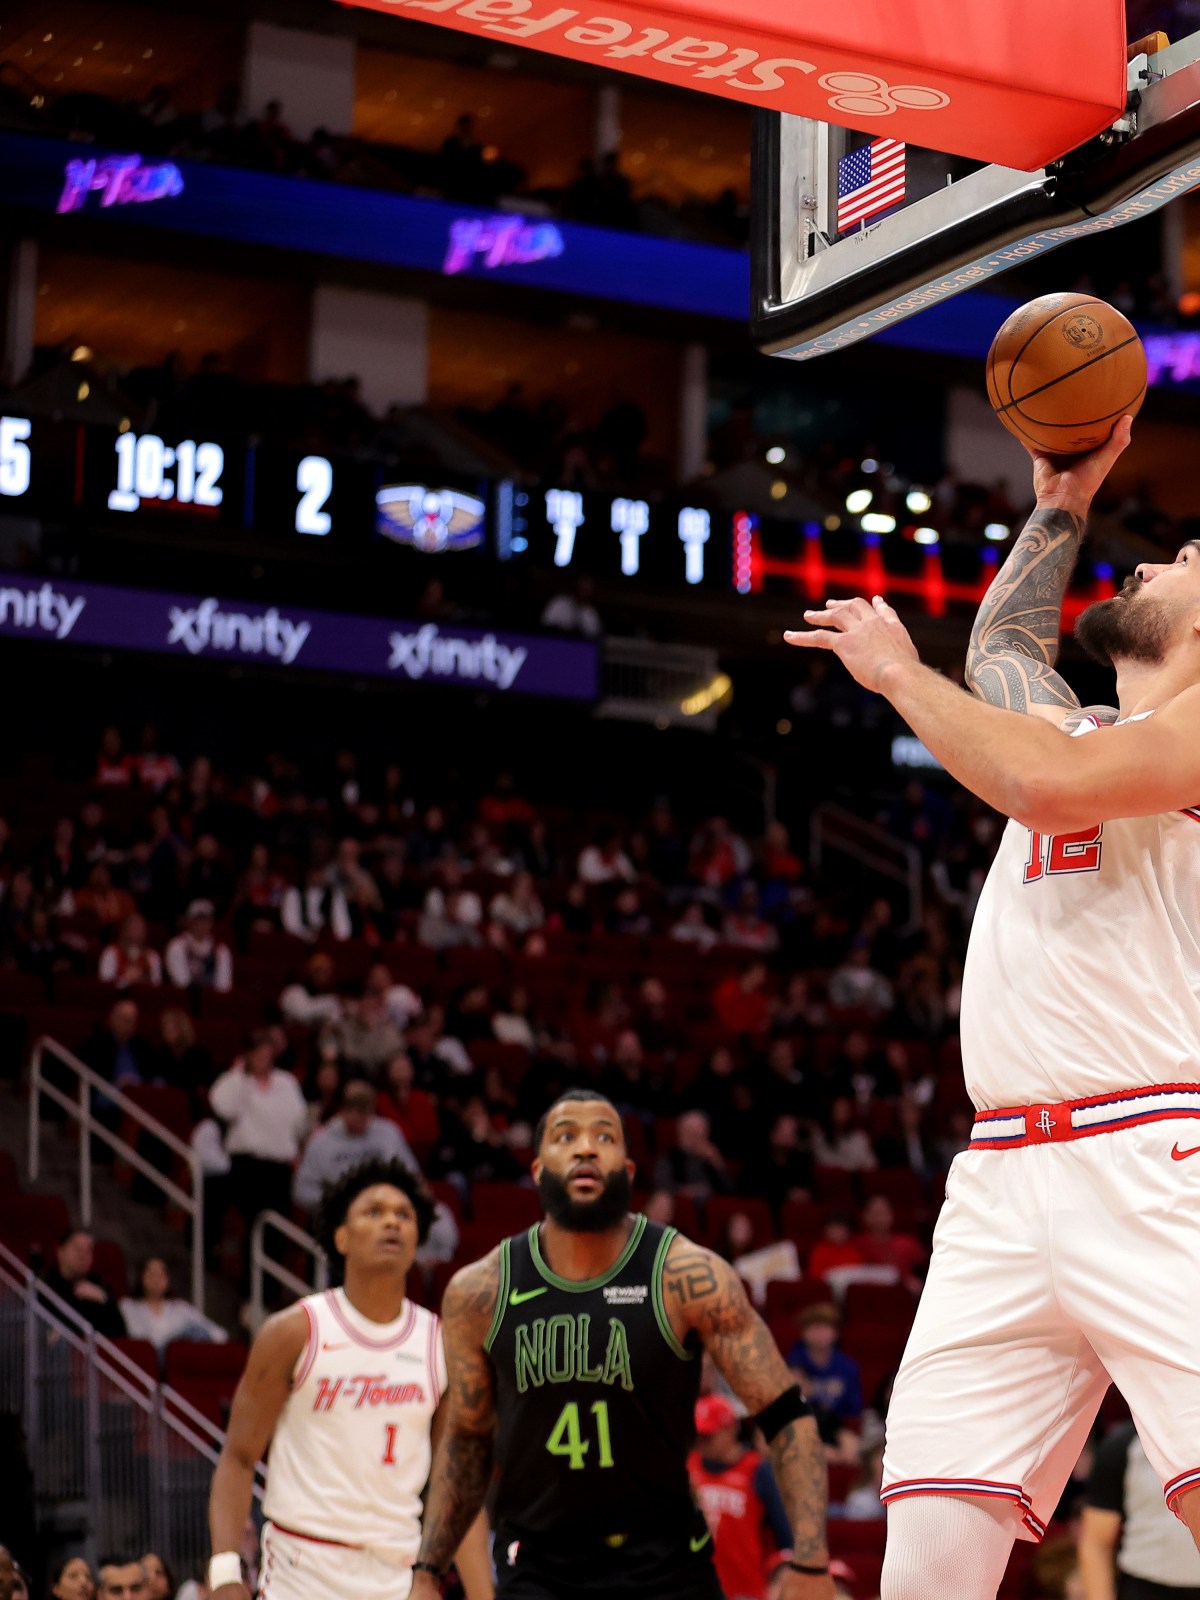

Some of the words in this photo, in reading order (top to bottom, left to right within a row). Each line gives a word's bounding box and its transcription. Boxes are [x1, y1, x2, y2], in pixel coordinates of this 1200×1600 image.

[868, 265, 993, 321] veraclinic.net
[996, 240, 1045, 261] Hair
[1035, 200, 1153, 241] Transplant
[115, 431, 225, 507] 10:12
[295, 455, 334, 536] 2
[166, 598, 311, 664] xfinity
[388, 623, 528, 690] xfinity
[514, 1313, 635, 1394] NOLA
[312, 1373, 425, 1413] H-Town
[382, 1422, 398, 1467] 1
[545, 1399, 615, 1470] 41
